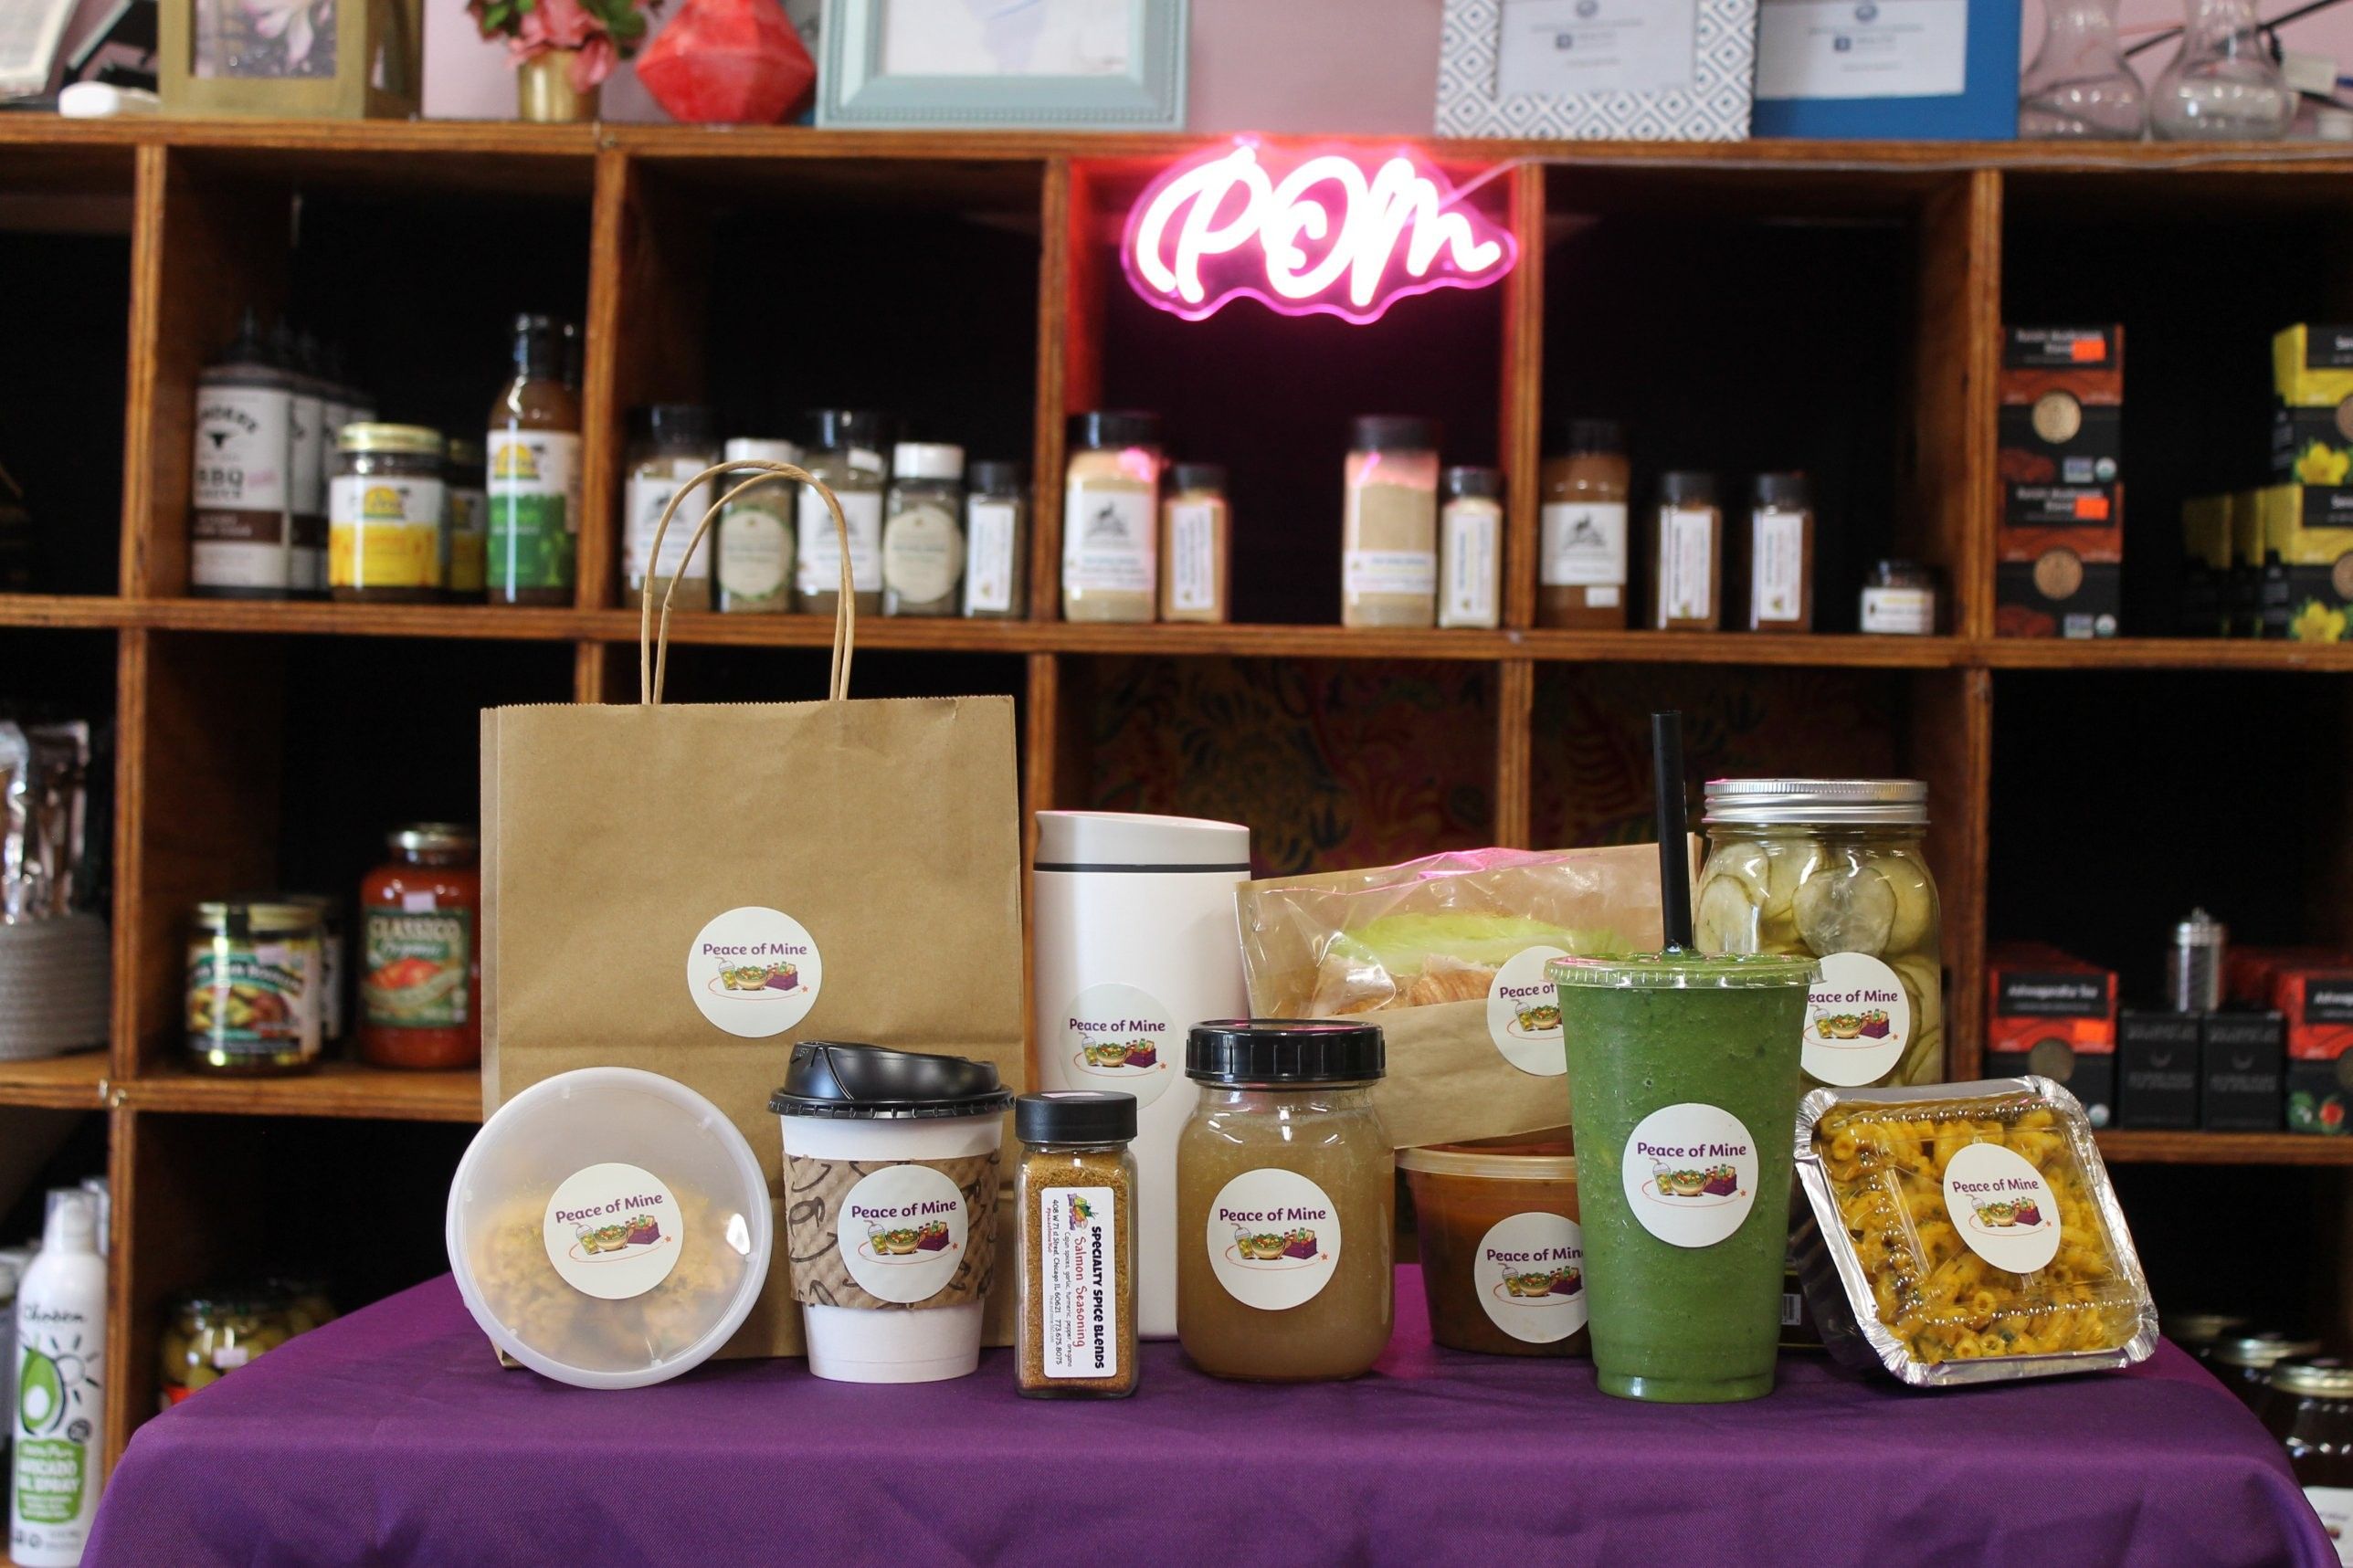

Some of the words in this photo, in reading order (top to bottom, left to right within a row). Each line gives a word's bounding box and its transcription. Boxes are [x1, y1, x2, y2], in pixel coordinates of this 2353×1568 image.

[703, 943, 747, 955] Peace
[751, 943, 767, 955] of
[771, 943, 807, 955] Mine
[1500, 986, 1539, 998] Peace
[1807, 993, 1842, 1004] eace
[1846, 990, 1862, 1003] of
[1864, 990, 1898, 1003] Mine
[1070, 1018, 1107, 1032] Peace
[1111, 1020, 1126, 1032] of
[1129, 1020, 1166, 1032] Mine
[1638, 1142, 1684, 1158] Peace
[1689, 1143, 1706, 1158] of
[1709, 1143, 1746, 1158] Mine
[1952, 1181, 1990, 1193] Peace
[1992, 1179, 2005, 1192] of
[2008, 1177, 2039, 1191] Mine
[555, 1206, 602, 1224] Peace
[606, 1199, 621, 1213] of
[625, 1194, 663, 1210] Mine
[852, 1205, 897, 1218] Peace
[902, 1203, 919, 1217] of
[922, 1200, 957, 1215] Mine
[1219, 1208, 1262, 1222] Peace
[1267, 1207, 1284, 1222] of
[1287, 1207, 1326, 1221] Mine
[1062, 1231, 1071, 1247] Cajun
[1074, 1237, 1087, 1280] Salmon
[1486, 1248, 1529, 1262] Peace
[1534, 1248, 1549, 1261] of
[1553, 1247, 1583, 1260] Min
[1052, 1258, 1060, 1282] Chicago
[1072, 1286, 1088, 1347] Seasoning
